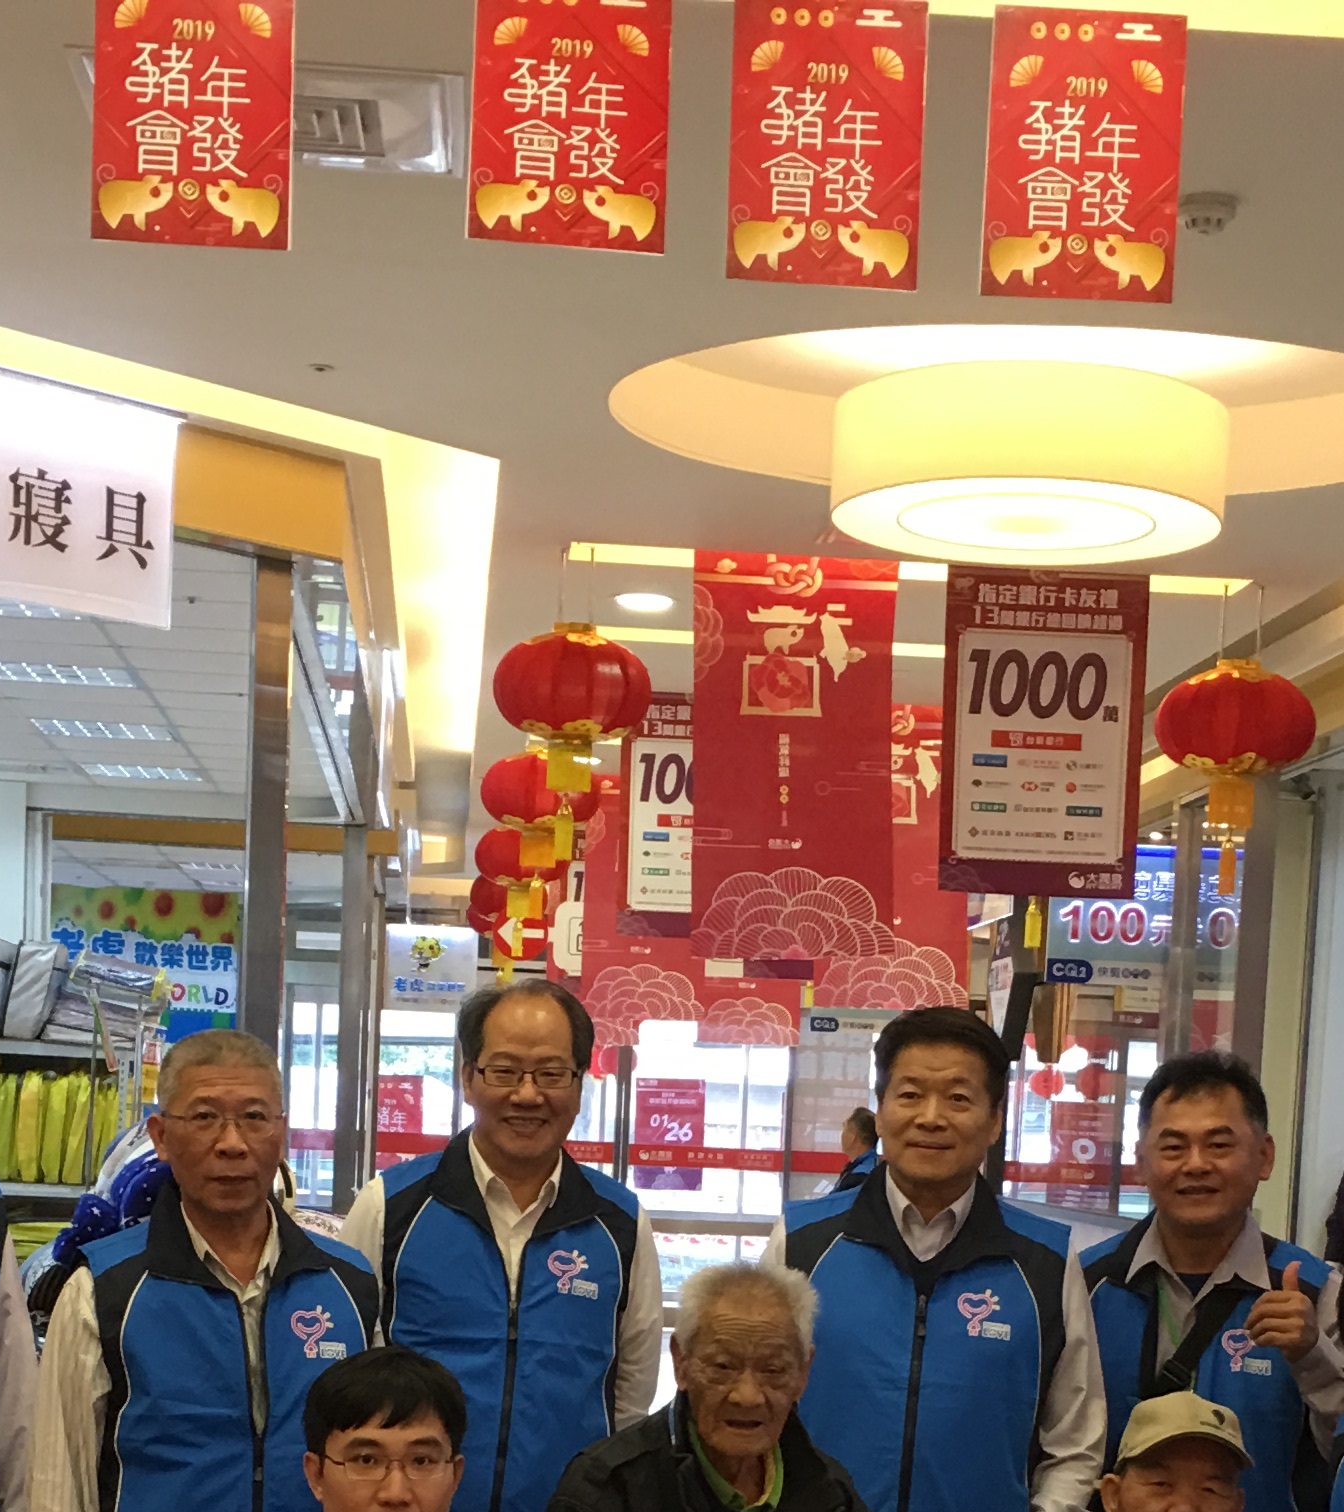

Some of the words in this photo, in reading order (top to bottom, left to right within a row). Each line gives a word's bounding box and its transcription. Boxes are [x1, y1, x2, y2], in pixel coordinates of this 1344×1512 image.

[172, 18, 215, 41] 2019
[551, 37, 594, 59] 2019
[125, 41, 251, 118] 豬年
[503, 57, 629, 129] 豬年
[807, 62, 849, 85] 2019
[1066, 75, 1108, 99] 2019
[126, 109, 248, 178] 會發
[503, 119, 625, 185] 會發
[760, 84, 882, 160] 豬年
[1018, 99, 1141, 173] 豬年
[760, 151, 879, 219] 會發
[1018, 165, 1135, 233] 會發
[638, 753, 694, 805] 10
